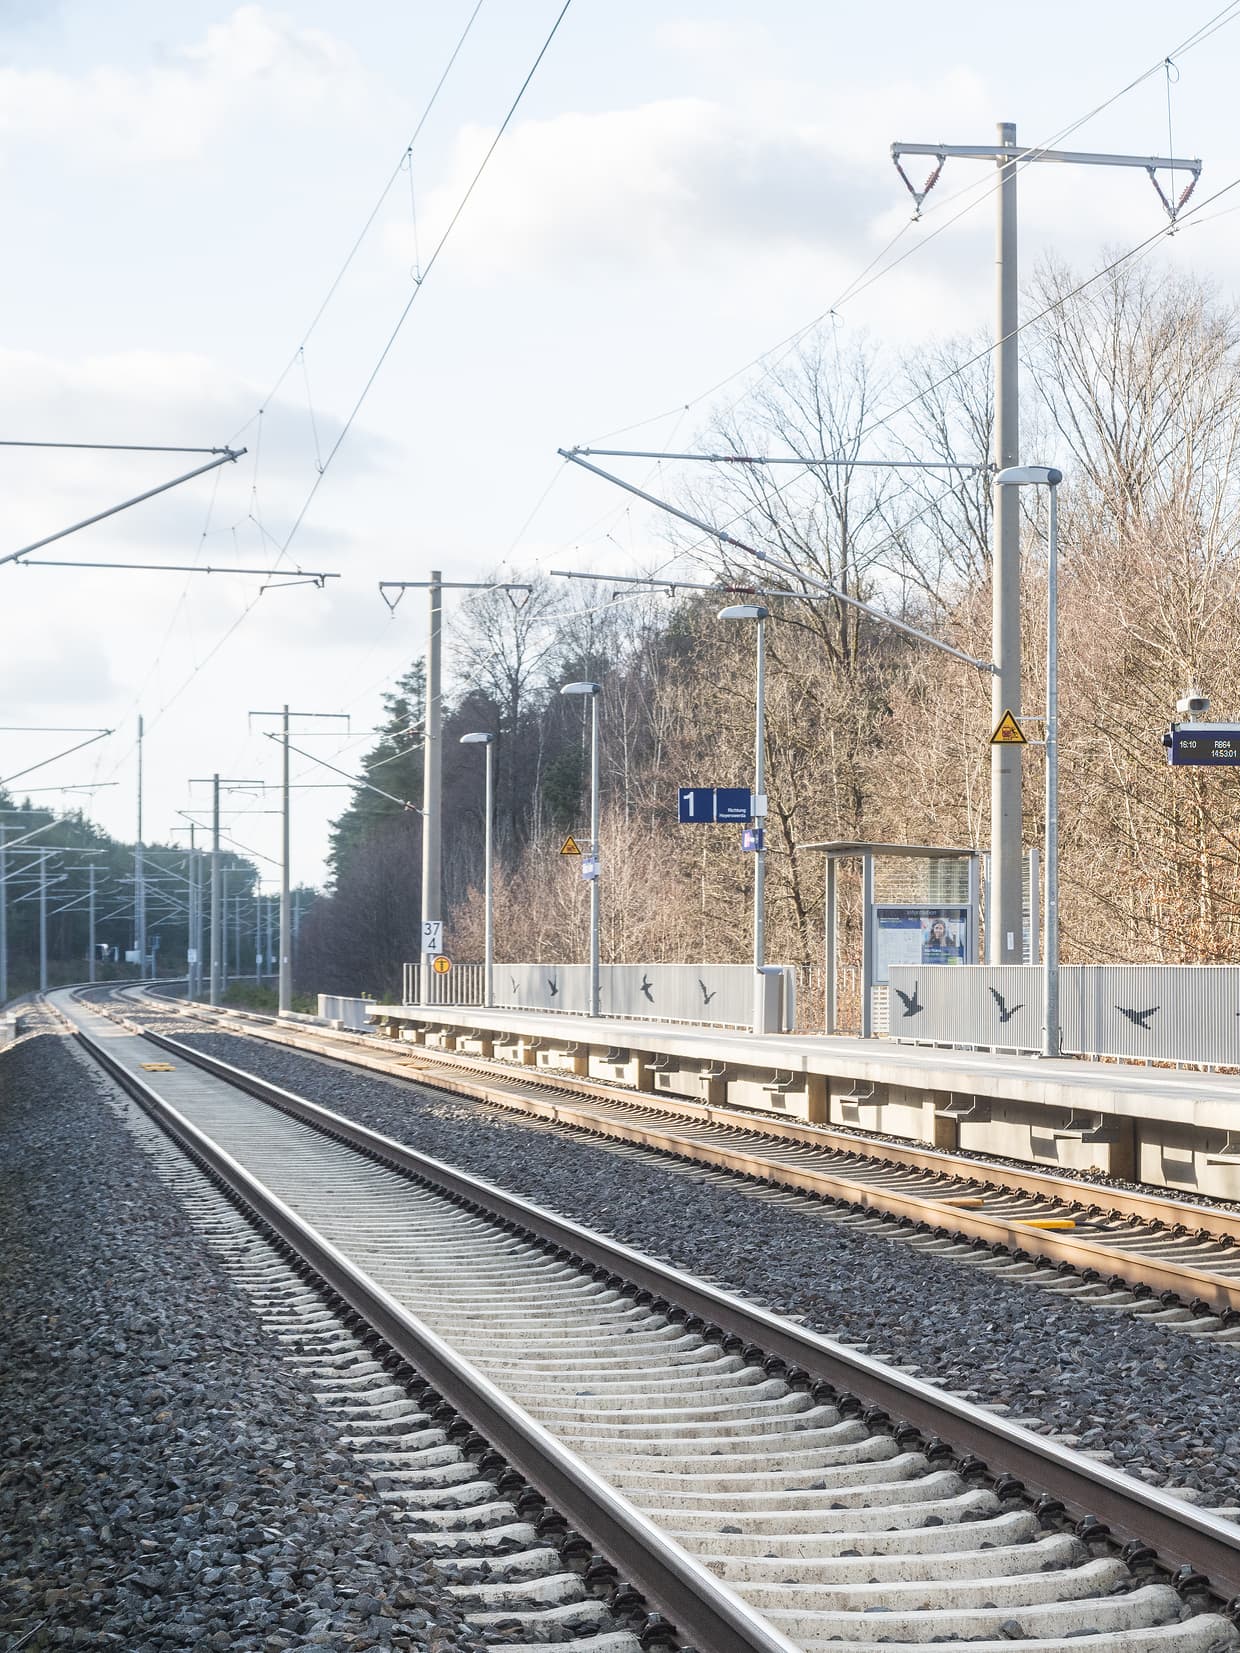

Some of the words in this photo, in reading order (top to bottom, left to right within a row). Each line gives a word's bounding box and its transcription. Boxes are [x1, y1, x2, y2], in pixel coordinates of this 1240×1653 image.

[683, 791, 694, 817] 1
[424, 922, 441, 936] 37
[427, 937, 437, 950] 4
